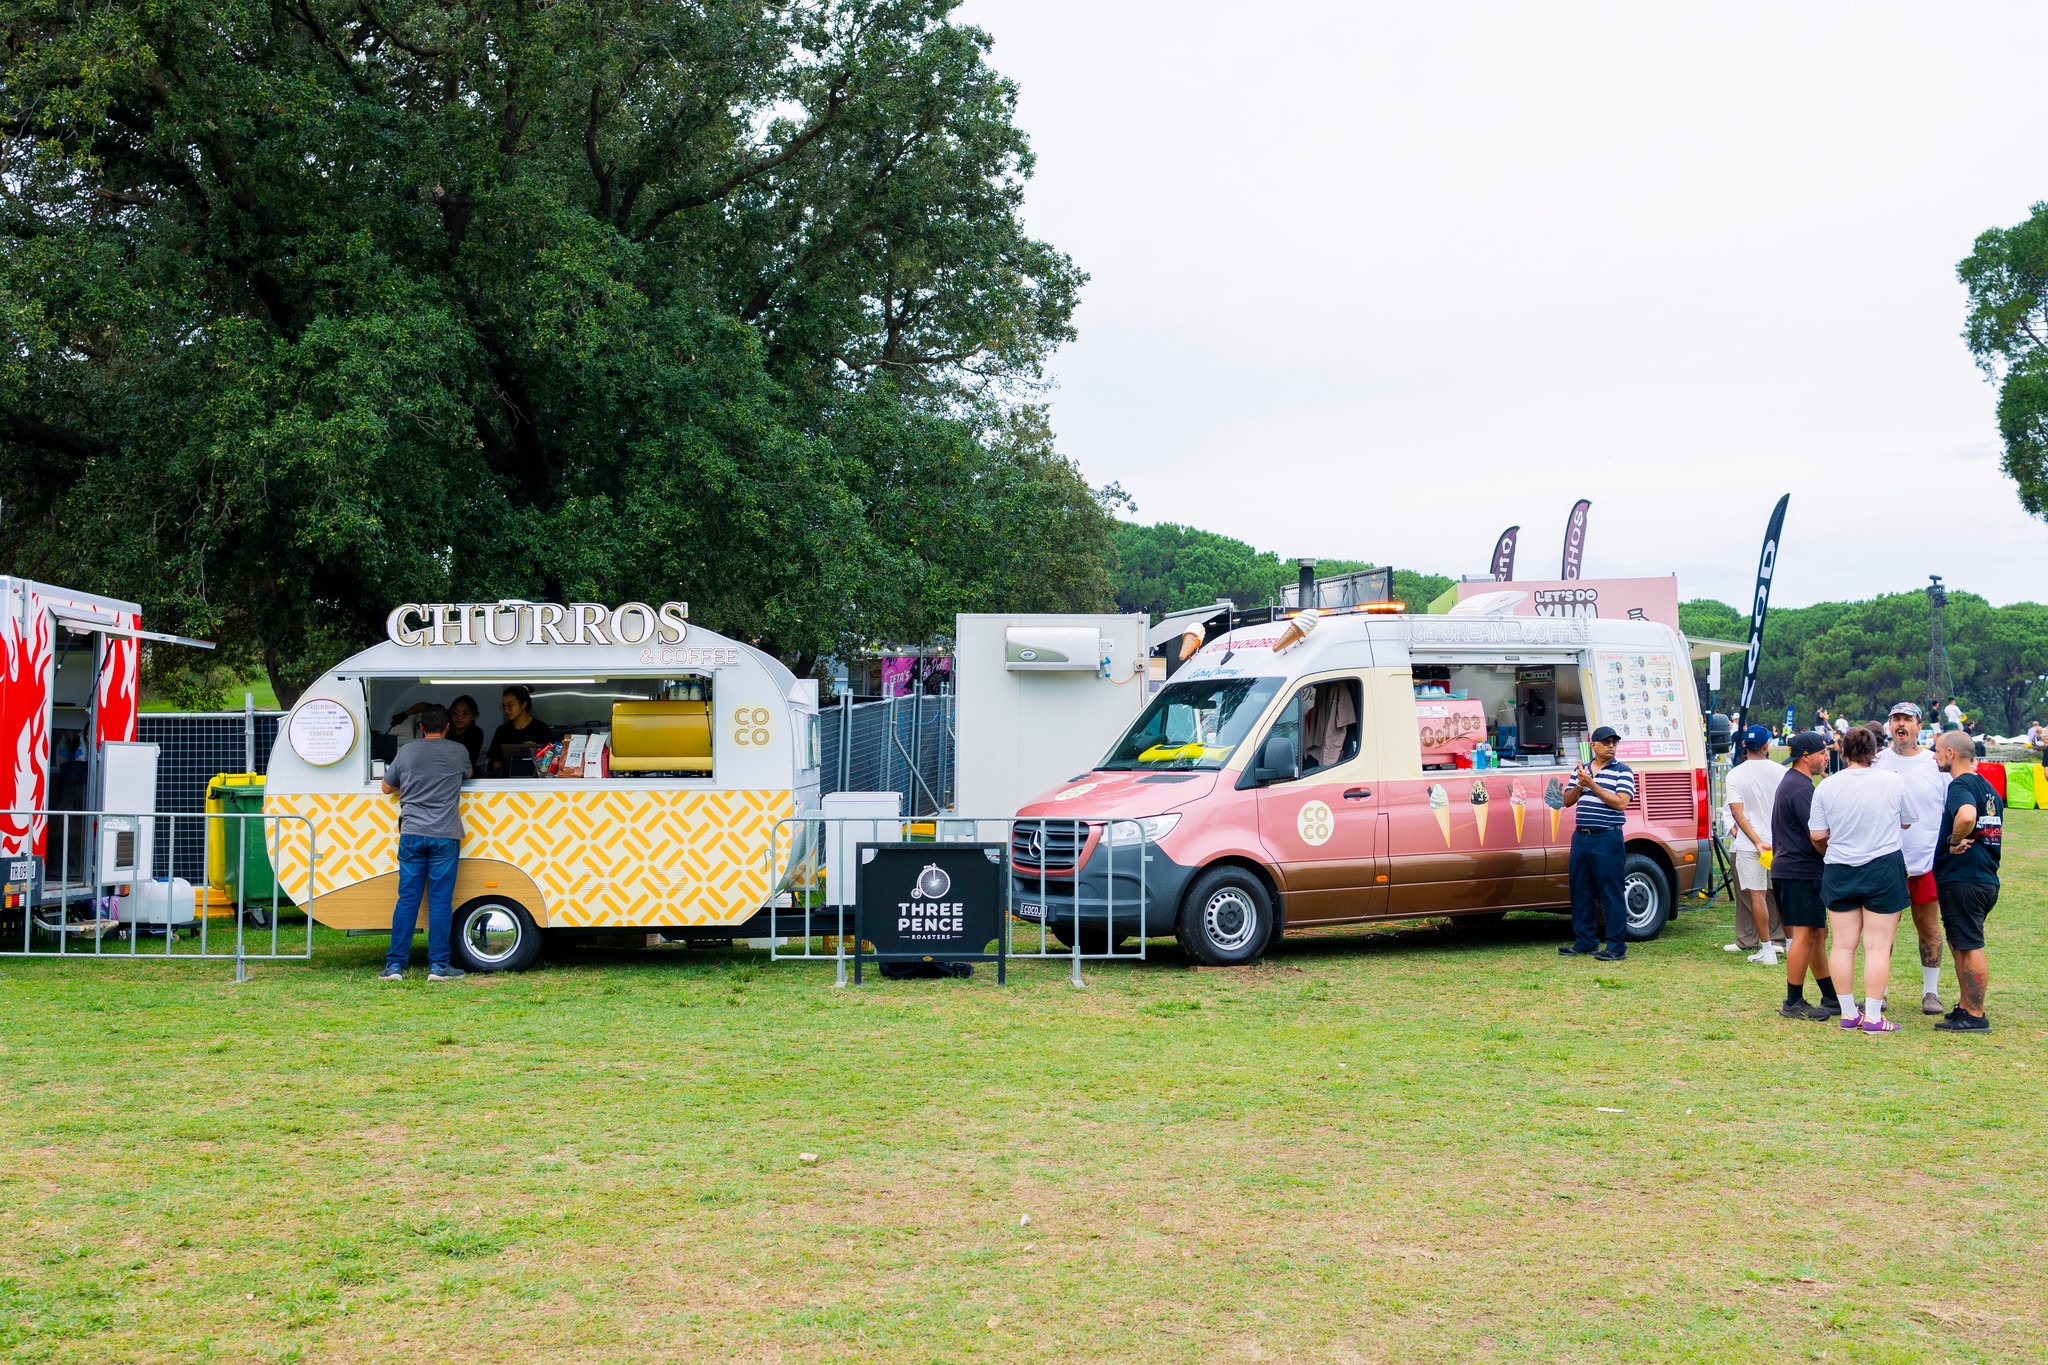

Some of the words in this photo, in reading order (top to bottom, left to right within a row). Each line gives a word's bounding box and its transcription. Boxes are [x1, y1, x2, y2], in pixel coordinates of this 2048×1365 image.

[1535, 589, 1575, 603] LET'S
[1575, 588, 1598, 602] DO
[386, 601, 689, 647] CHURROS
[1404, 621, 1437, 643] ICE
[1441, 621, 1508, 643] CREAM
[1521, 621, 1593, 643] COFFEE
[1205, 639, 1241, 654] CAUTION
[639, 648, 655, 665] &
[659, 648, 741, 665] COFFEE
[890, 670, 910, 683] TETA'S
[734, 707, 770, 726] CO
[734, 728, 770, 746] CO
[1421, 712, 1481, 748] Coffee
[1303, 806, 1328, 822] CO
[1303, 824, 1329, 839] CO
[898, 902, 963, 916] THREE
[898, 918, 963, 932] PENCE
